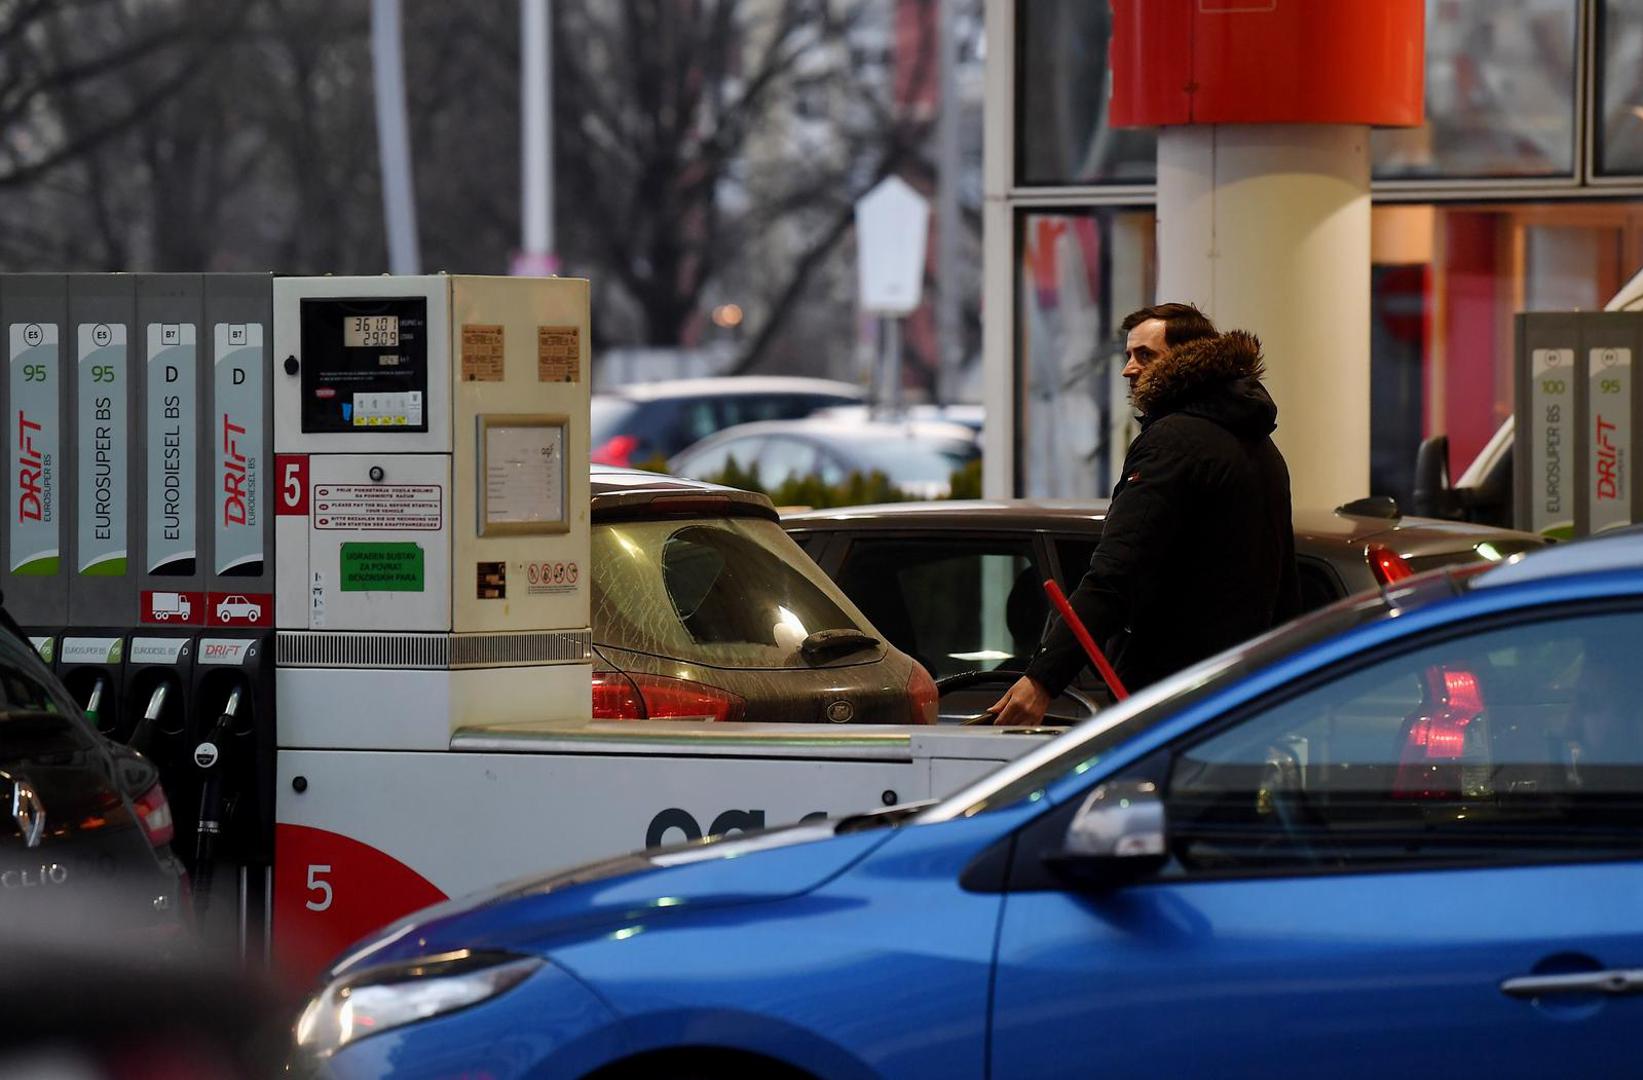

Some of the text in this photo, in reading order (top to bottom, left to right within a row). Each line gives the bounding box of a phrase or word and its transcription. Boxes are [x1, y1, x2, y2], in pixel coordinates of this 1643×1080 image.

[354, 317, 397, 332] 361.01
[28, 331, 38, 339] E5
[97, 331, 107, 339] E5
[363, 331, 397, 347] 29.09
[22, 364, 46, 382] 95
[91, 366, 115, 383] 95
[166, 366, 178, 382] D
[233, 368, 246, 385] D
[1542, 380, 1565, 394] 100
[1600, 380, 1621, 394] 95
[1546, 404, 1561, 514] EUROSUPER BS
[1596, 414, 1616, 501] DRIFT
[19, 410, 42, 524] DRIFT
[95, 397, 112, 540] EUROSUPER BS
[164, 395, 180, 540] EURODIESEL BS
[224, 414, 248, 527] DRIFT
[43, 454, 52, 522] EUROSUPER BS
[248, 456, 256, 526] EURODIESEL BS
[283, 464, 301, 507] 5
[182, 647, 188, 656] D
[204, 645, 242, 656] DRIFT
[250, 648, 256, 656] D
[1, 864, 68, 889] CLIO
[304, 864, 333, 912] 5
